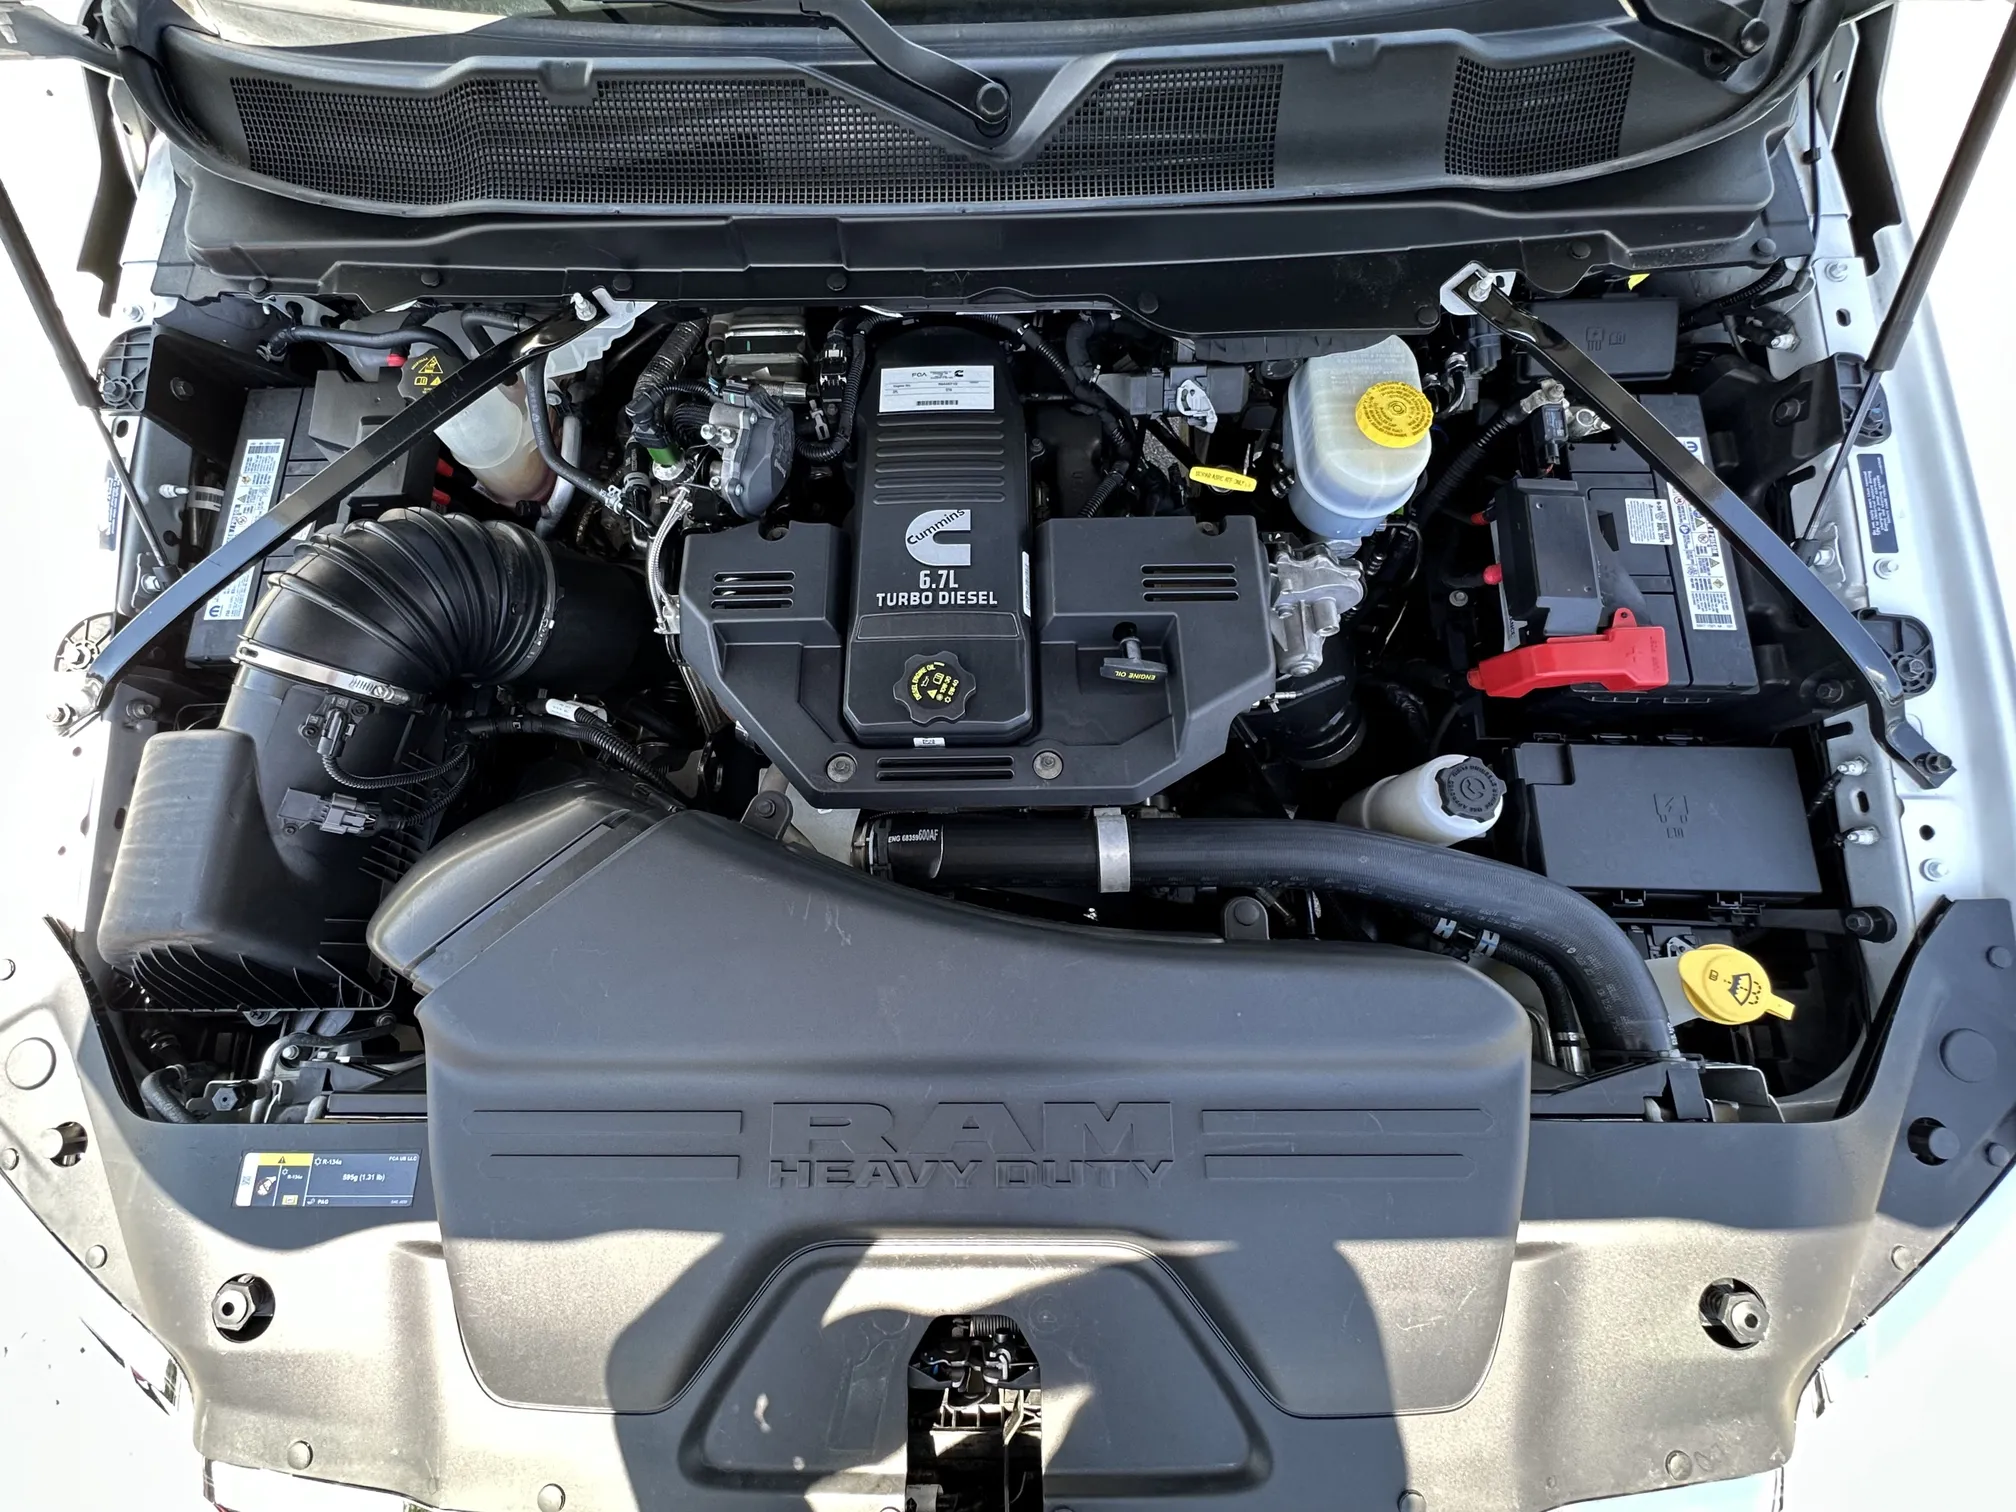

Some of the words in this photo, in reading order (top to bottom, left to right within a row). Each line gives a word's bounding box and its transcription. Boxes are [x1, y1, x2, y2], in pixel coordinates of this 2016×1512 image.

[907, 509, 965, 545] Cummins
[919, 569, 959, 589] 6.7L
[876, 592, 933, 606] TURBO
[938, 591, 998, 605] DIESEL
[926, 663, 936, 671] OIL
[1114, 670, 1127, 678] OIL
[912, 666, 928, 684] ENGINE
[1128, 672, 1156, 681] ENGINE
[911, 684, 922, 701] DIESEL
[888, 834, 901, 843] ENG
[769, 1101, 1174, 1156] RAM
[321, 1158, 343, 1166] R-134a
[375, 1173, 386, 1183] lb)
[768, 1159, 982, 1189] HEAVY
[995, 1159, 1174, 1189] DUTY
